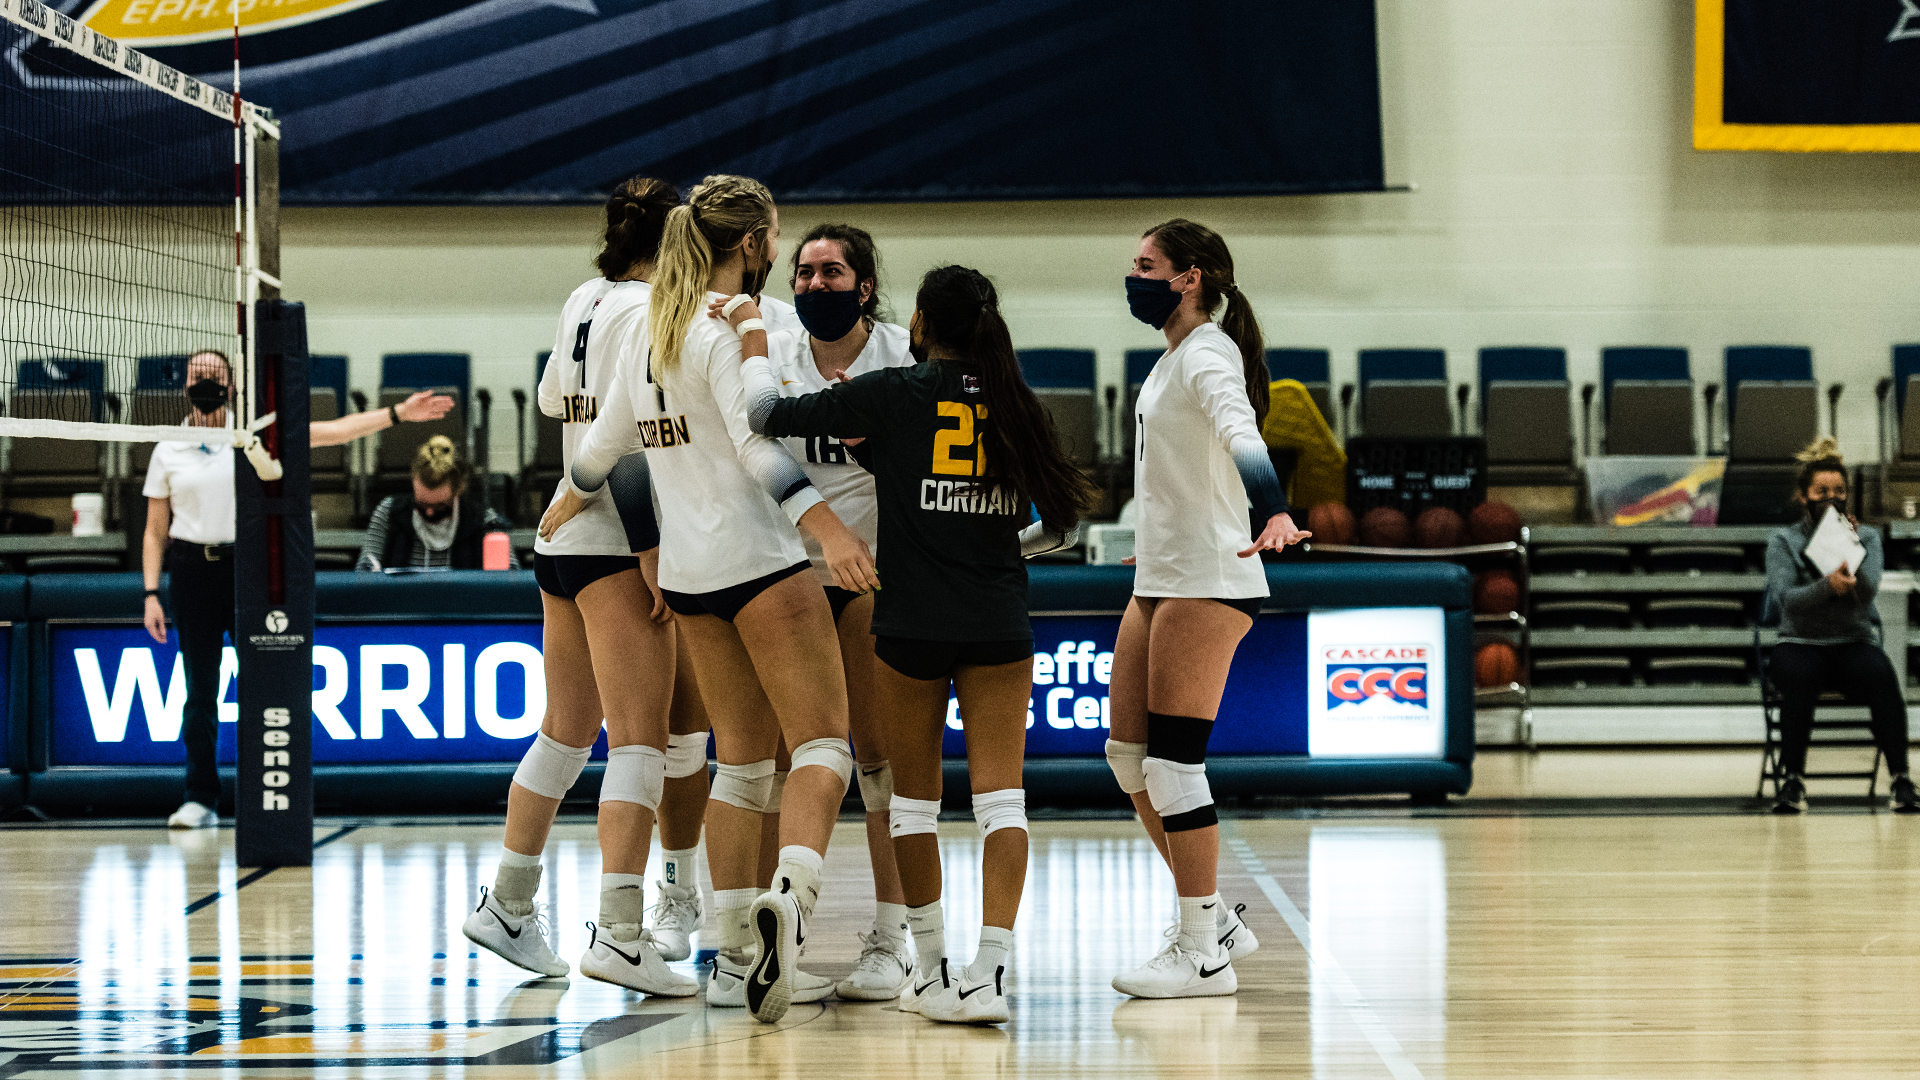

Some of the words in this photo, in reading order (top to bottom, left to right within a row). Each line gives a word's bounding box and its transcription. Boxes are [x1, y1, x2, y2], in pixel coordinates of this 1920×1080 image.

[1360, 475, 1396, 490] HOME
[1032, 640, 1115, 685] effe
[1326, 648, 1427, 660] CASCADE
[74, 641, 548, 743] WRRIO
[1327, 667, 1427, 700] CCC
